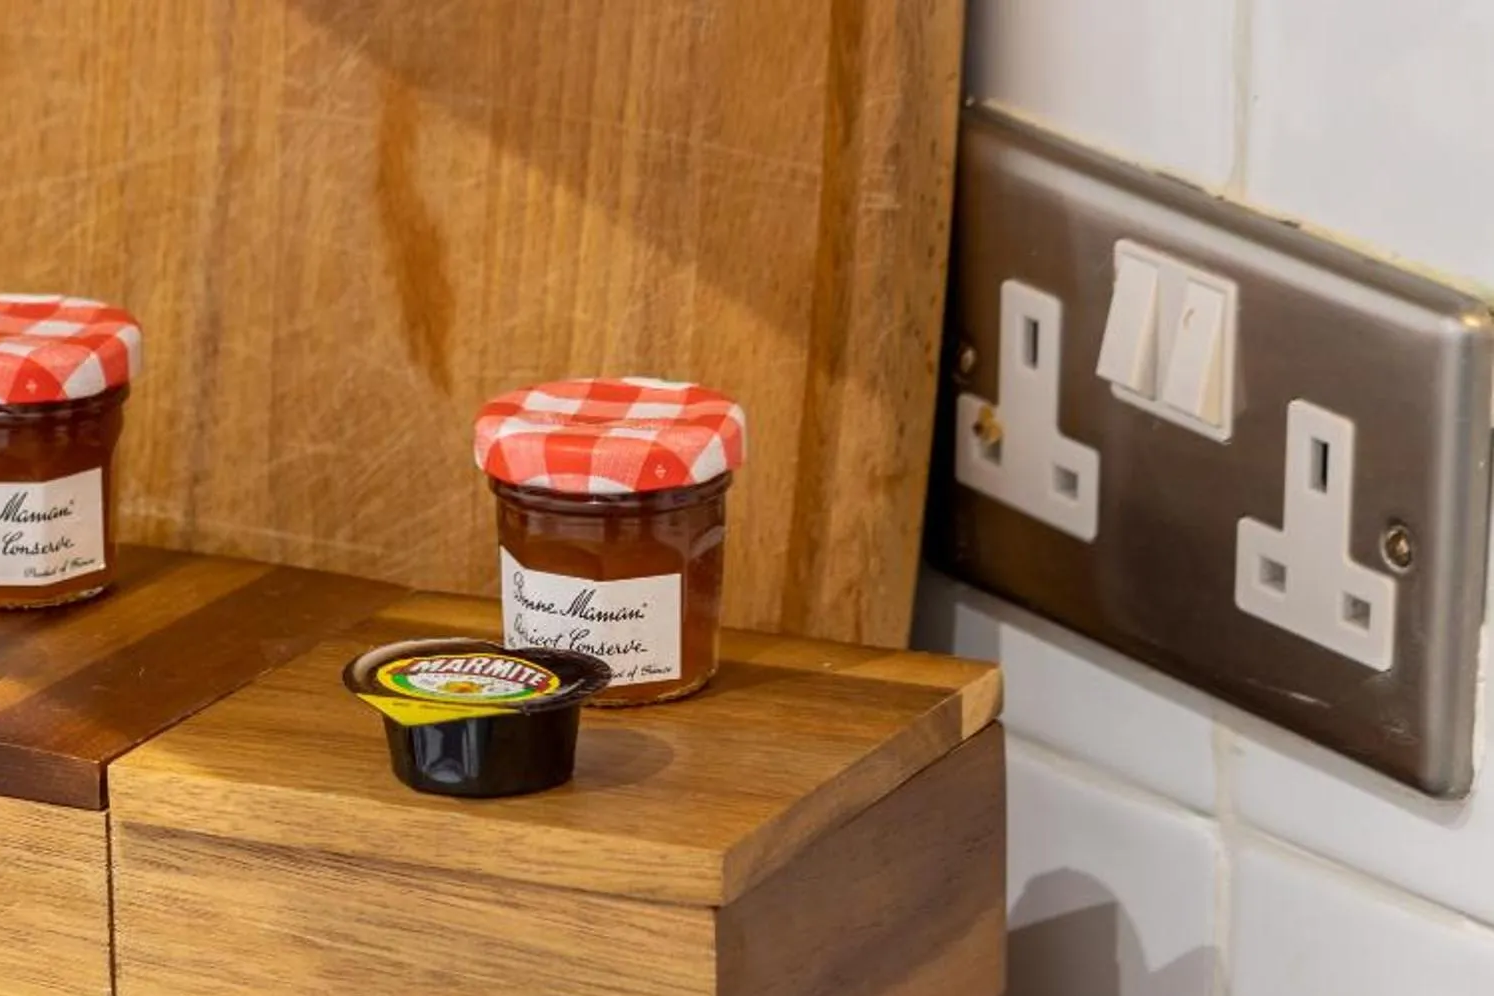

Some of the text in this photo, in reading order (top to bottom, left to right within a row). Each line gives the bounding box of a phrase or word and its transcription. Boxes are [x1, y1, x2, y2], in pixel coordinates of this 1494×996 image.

[2, 531, 75, 556] Conserve
[514, 571, 644, 622] Bonne Maman
[570, 628, 647, 656] Conserve
[409, 657, 548, 687] MARMITE
